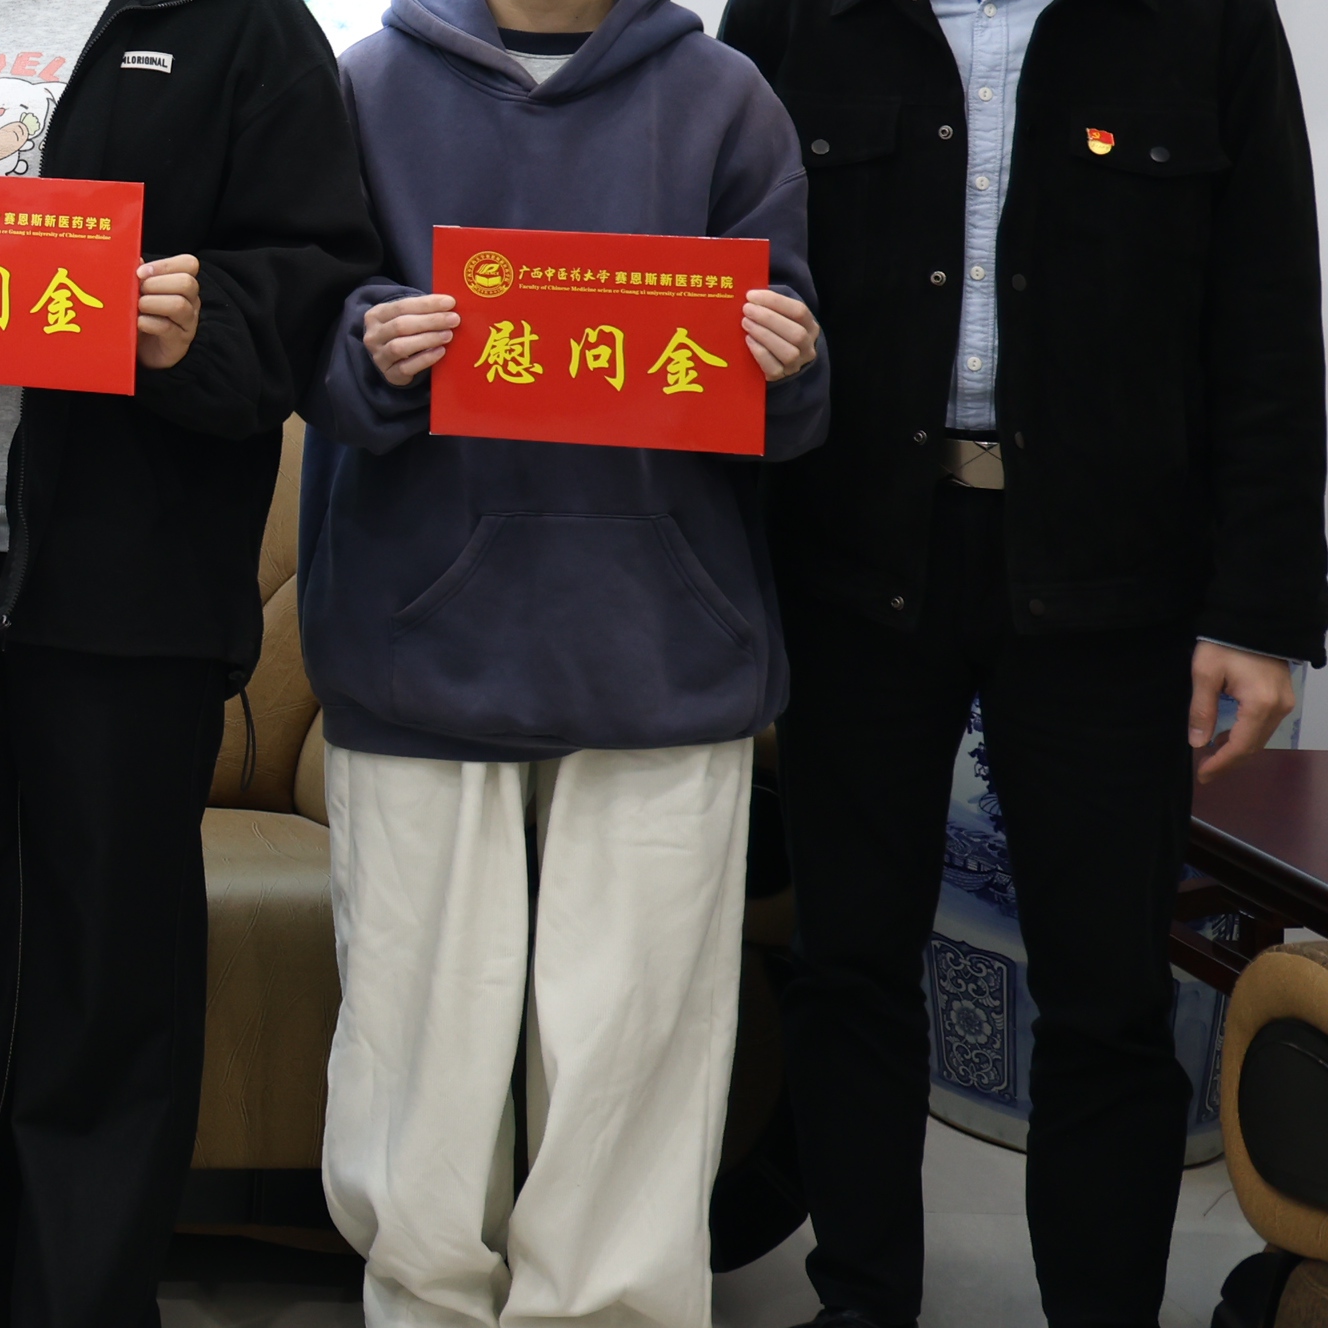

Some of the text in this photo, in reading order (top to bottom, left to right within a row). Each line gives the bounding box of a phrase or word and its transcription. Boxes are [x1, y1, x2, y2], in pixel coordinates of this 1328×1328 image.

[3, 211, 111, 231] 赛恩斯新医药学院
[517, 264, 734, 289] 广西中医药大学 赛恩斯新医药学院
[475, 320, 728, 394] 慰问金
